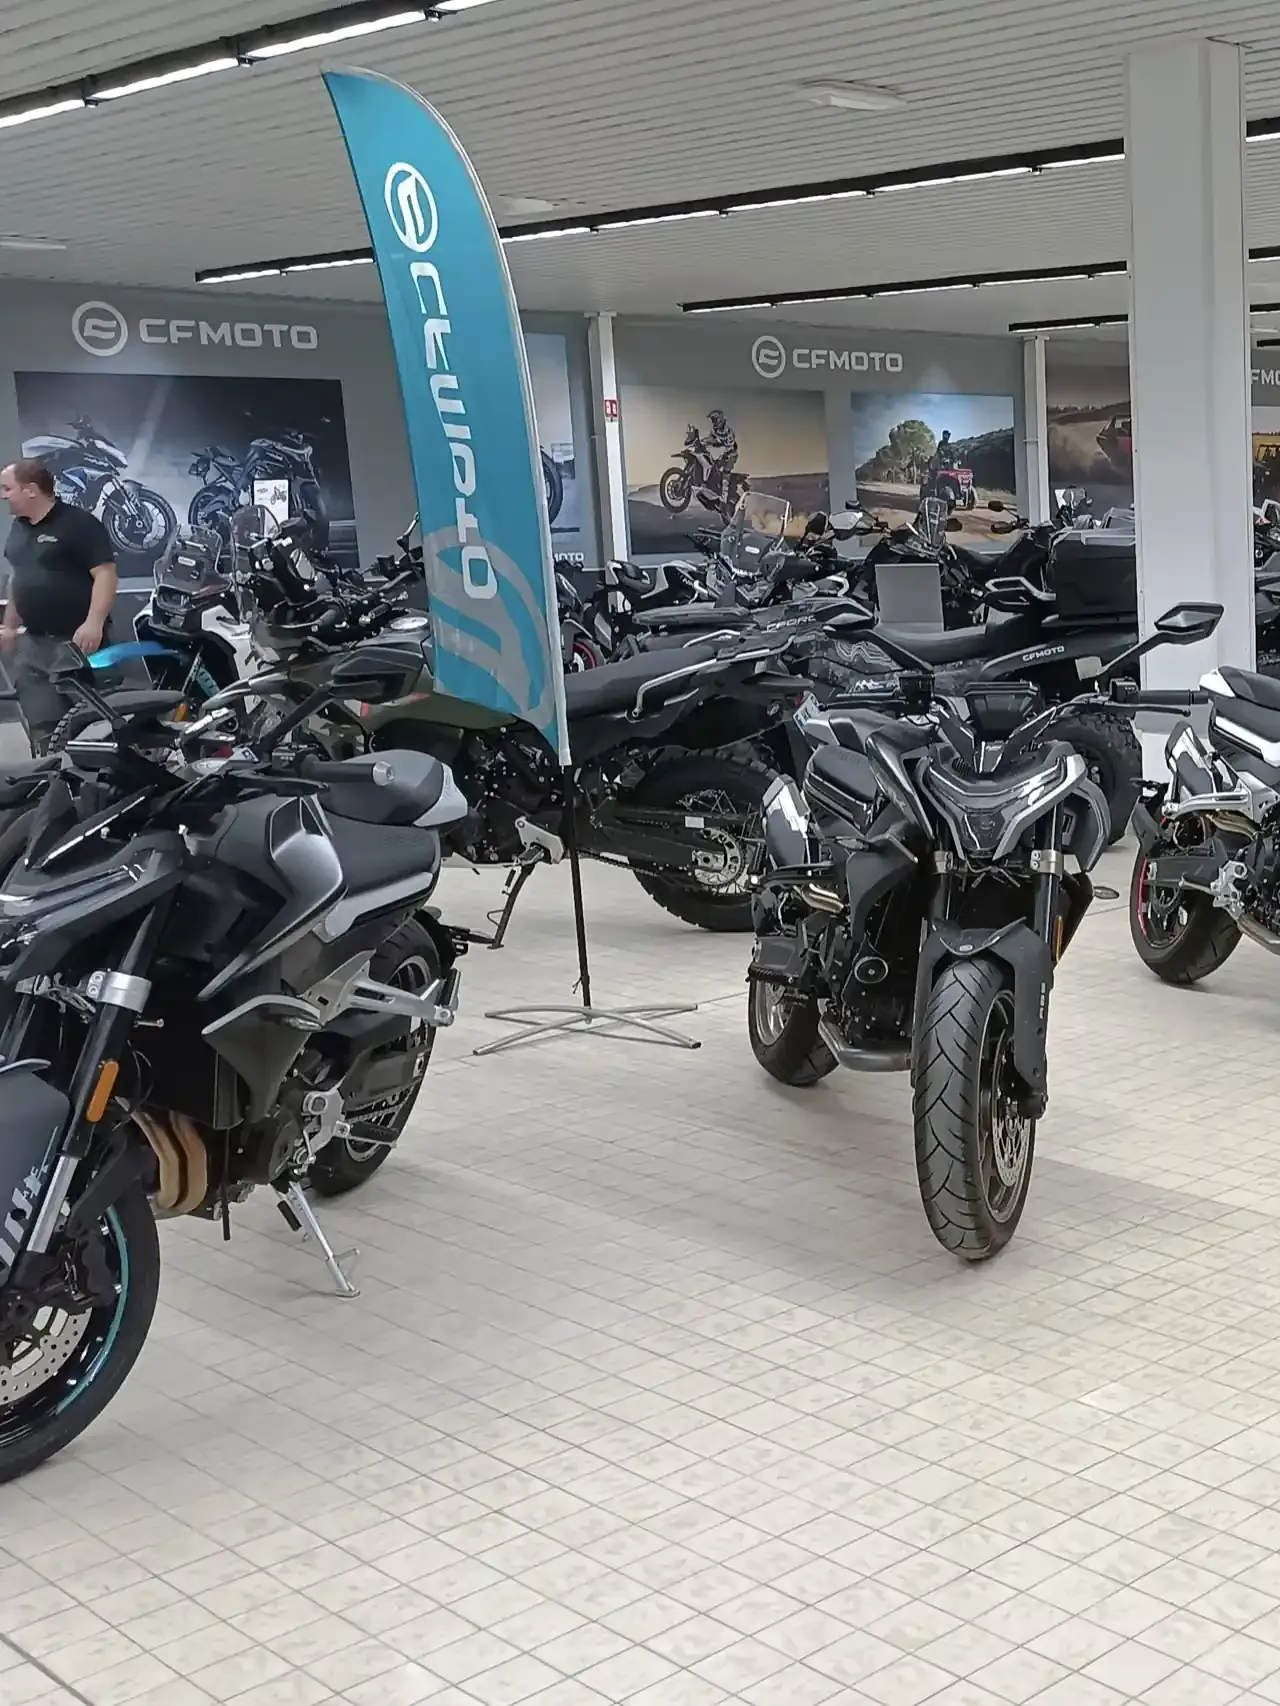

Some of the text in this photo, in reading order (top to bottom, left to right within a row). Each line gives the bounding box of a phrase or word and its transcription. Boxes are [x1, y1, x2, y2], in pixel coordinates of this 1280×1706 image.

[138, 318, 319, 350] CFMOTO
[792, 348, 904, 373] CFMOTO
[409, 261, 499, 600] CFMOTO
[1022, 645, 1065, 662] CFMOTO
